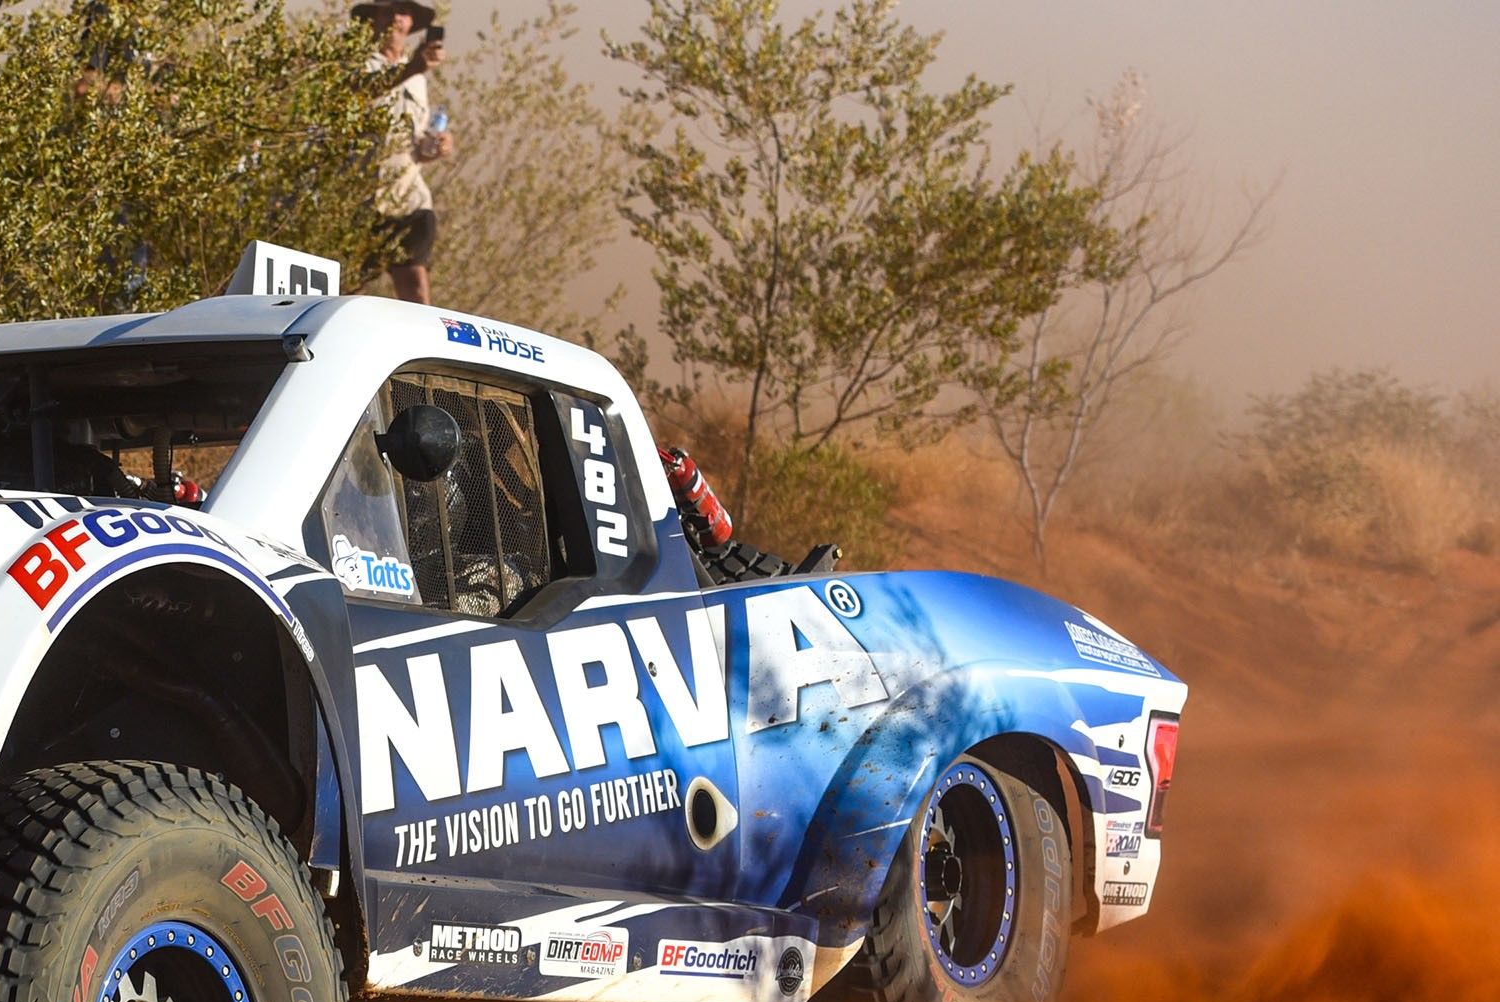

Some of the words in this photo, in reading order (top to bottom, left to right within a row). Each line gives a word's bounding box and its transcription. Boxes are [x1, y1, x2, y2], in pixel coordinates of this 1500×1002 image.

[486, 334, 545, 363] HOSE
[571, 407, 628, 558] 482
[6, 509, 248, 611] BFGood
[361, 556, 411, 591] Tatts
[355, 585, 889, 815] NARVA
[1111, 770, 1141, 786] SDG
[394, 818, 438, 867] THE
[445, 801, 520, 857] VISION
[524, 794, 553, 839] TO
[558, 787, 587, 833] GO
[590, 768, 682, 826] FURTHER
[1103, 884, 1146, 897] METHOD
[432, 924, 520, 952] METHOD
[431, 949, 462, 961] RACE
[468, 951, 518, 964] WHEELS
[580, 965, 615, 976] MAGAZINE
[661, 945, 757, 971] BFGoodrich
